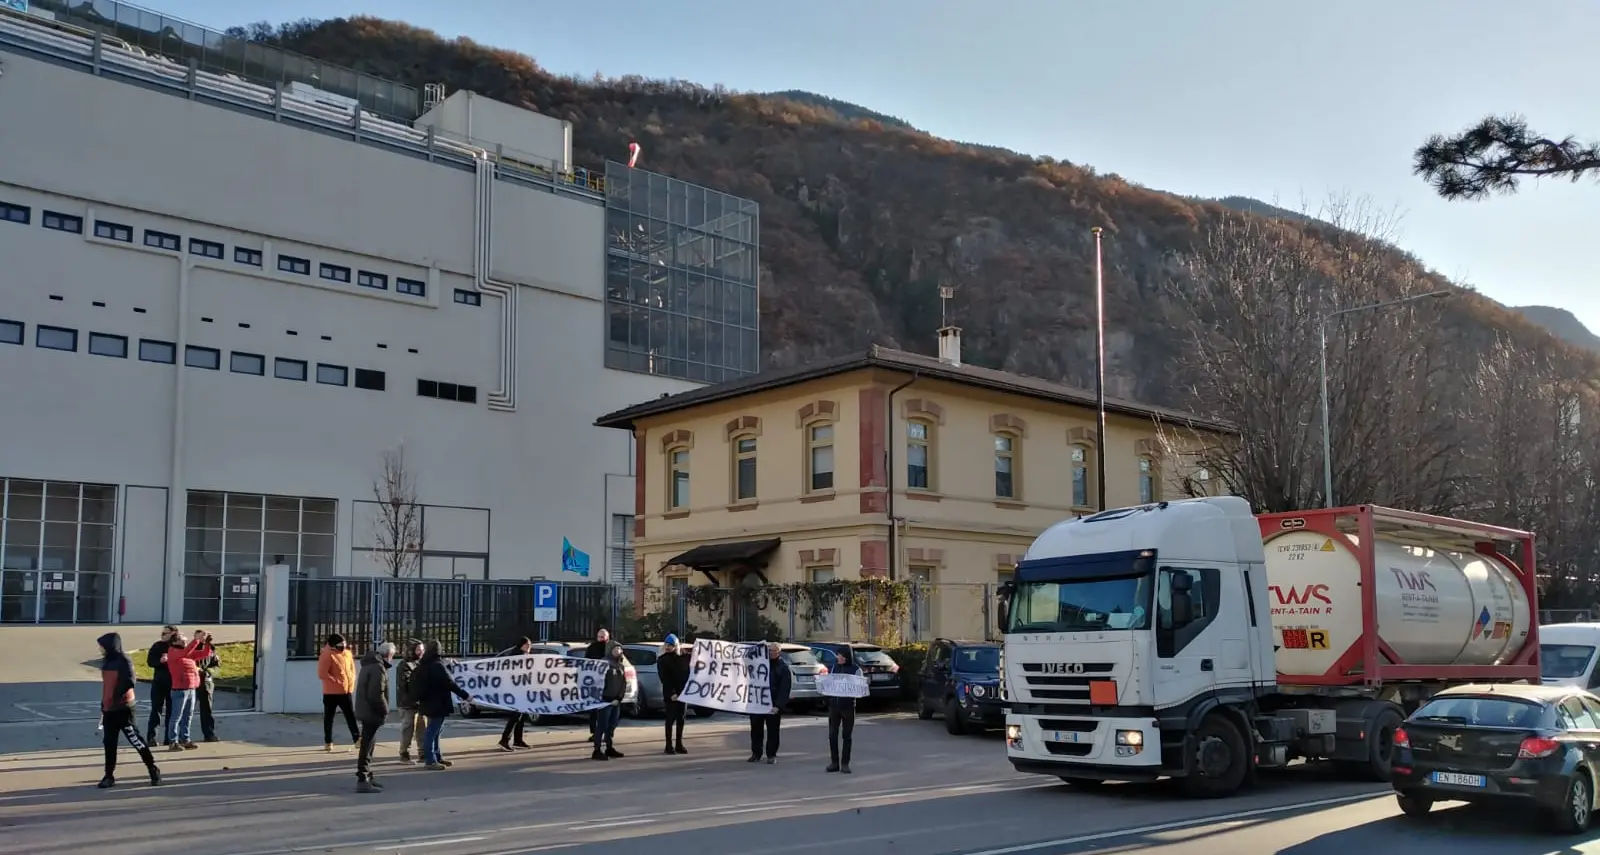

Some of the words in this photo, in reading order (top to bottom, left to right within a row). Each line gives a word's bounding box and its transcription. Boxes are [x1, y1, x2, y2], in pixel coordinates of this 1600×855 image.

[1389, 567, 1437, 592] TWS
[538, 585, 553, 606] P
[1310, 632, 1326, 648] R
[475, 658, 534, 671] CHIAMO
[545, 658, 608, 675] OPERAIO
[693, 660, 768, 682] PRETURA
[1042, 663, 1083, 674] IVECO
[454, 675, 501, 689] SONO
[511, 672, 532, 686] UN
[526, 689, 552, 703] UN
[684, 680, 731, 702] DOVE
[731, 684, 771, 706] SIETE
